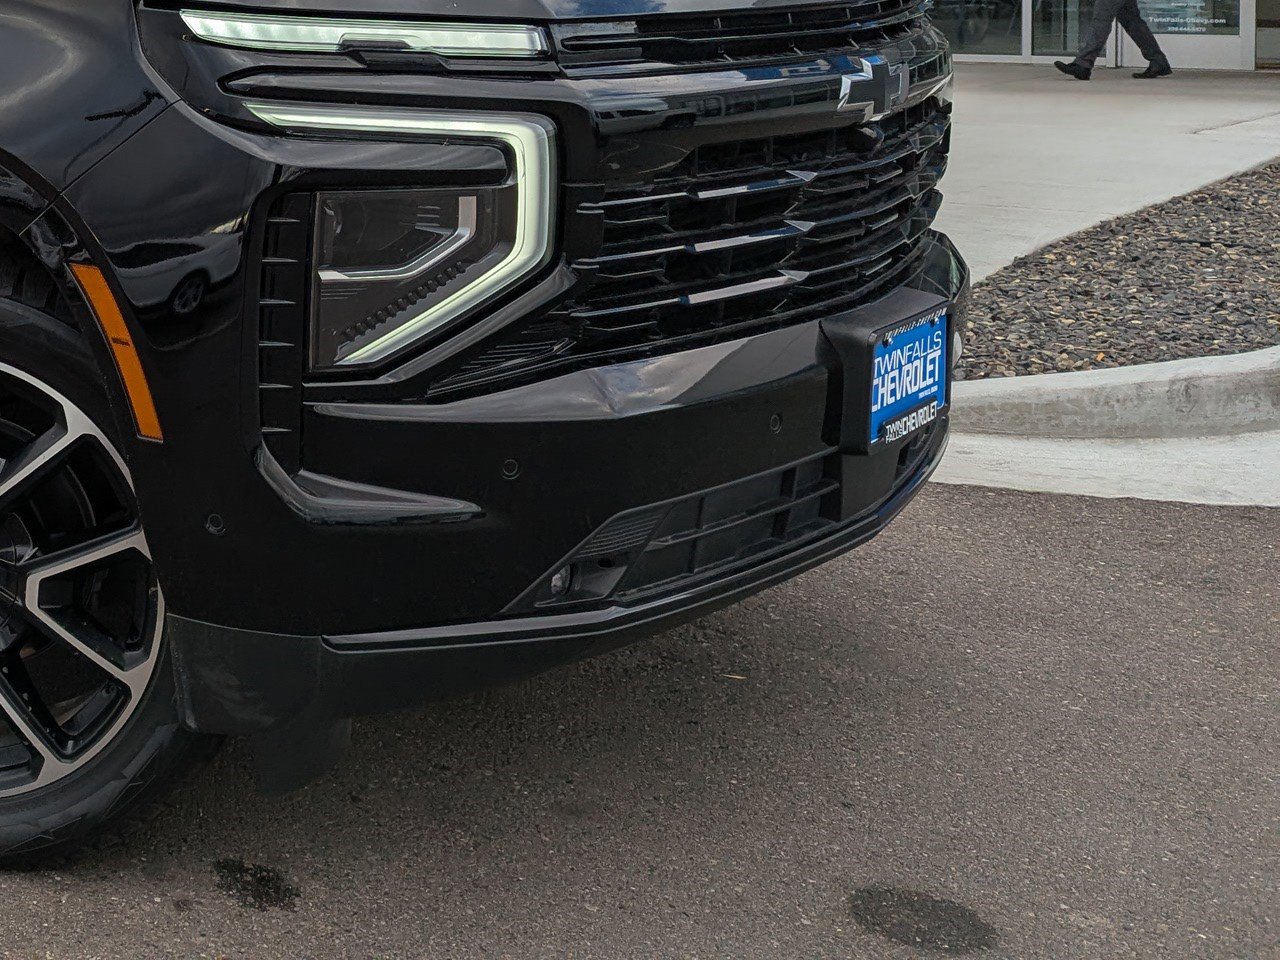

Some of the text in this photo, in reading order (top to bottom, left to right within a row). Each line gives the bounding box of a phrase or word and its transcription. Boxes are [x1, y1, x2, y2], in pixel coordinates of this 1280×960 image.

[874, 330, 942, 377] TWINFALLS
[871, 350, 942, 413] CHEVROLET
[885, 420, 903, 437] TWIN
[885, 428, 903, 444] FALLS
[902, 401, 938, 436] CHEVROLET
